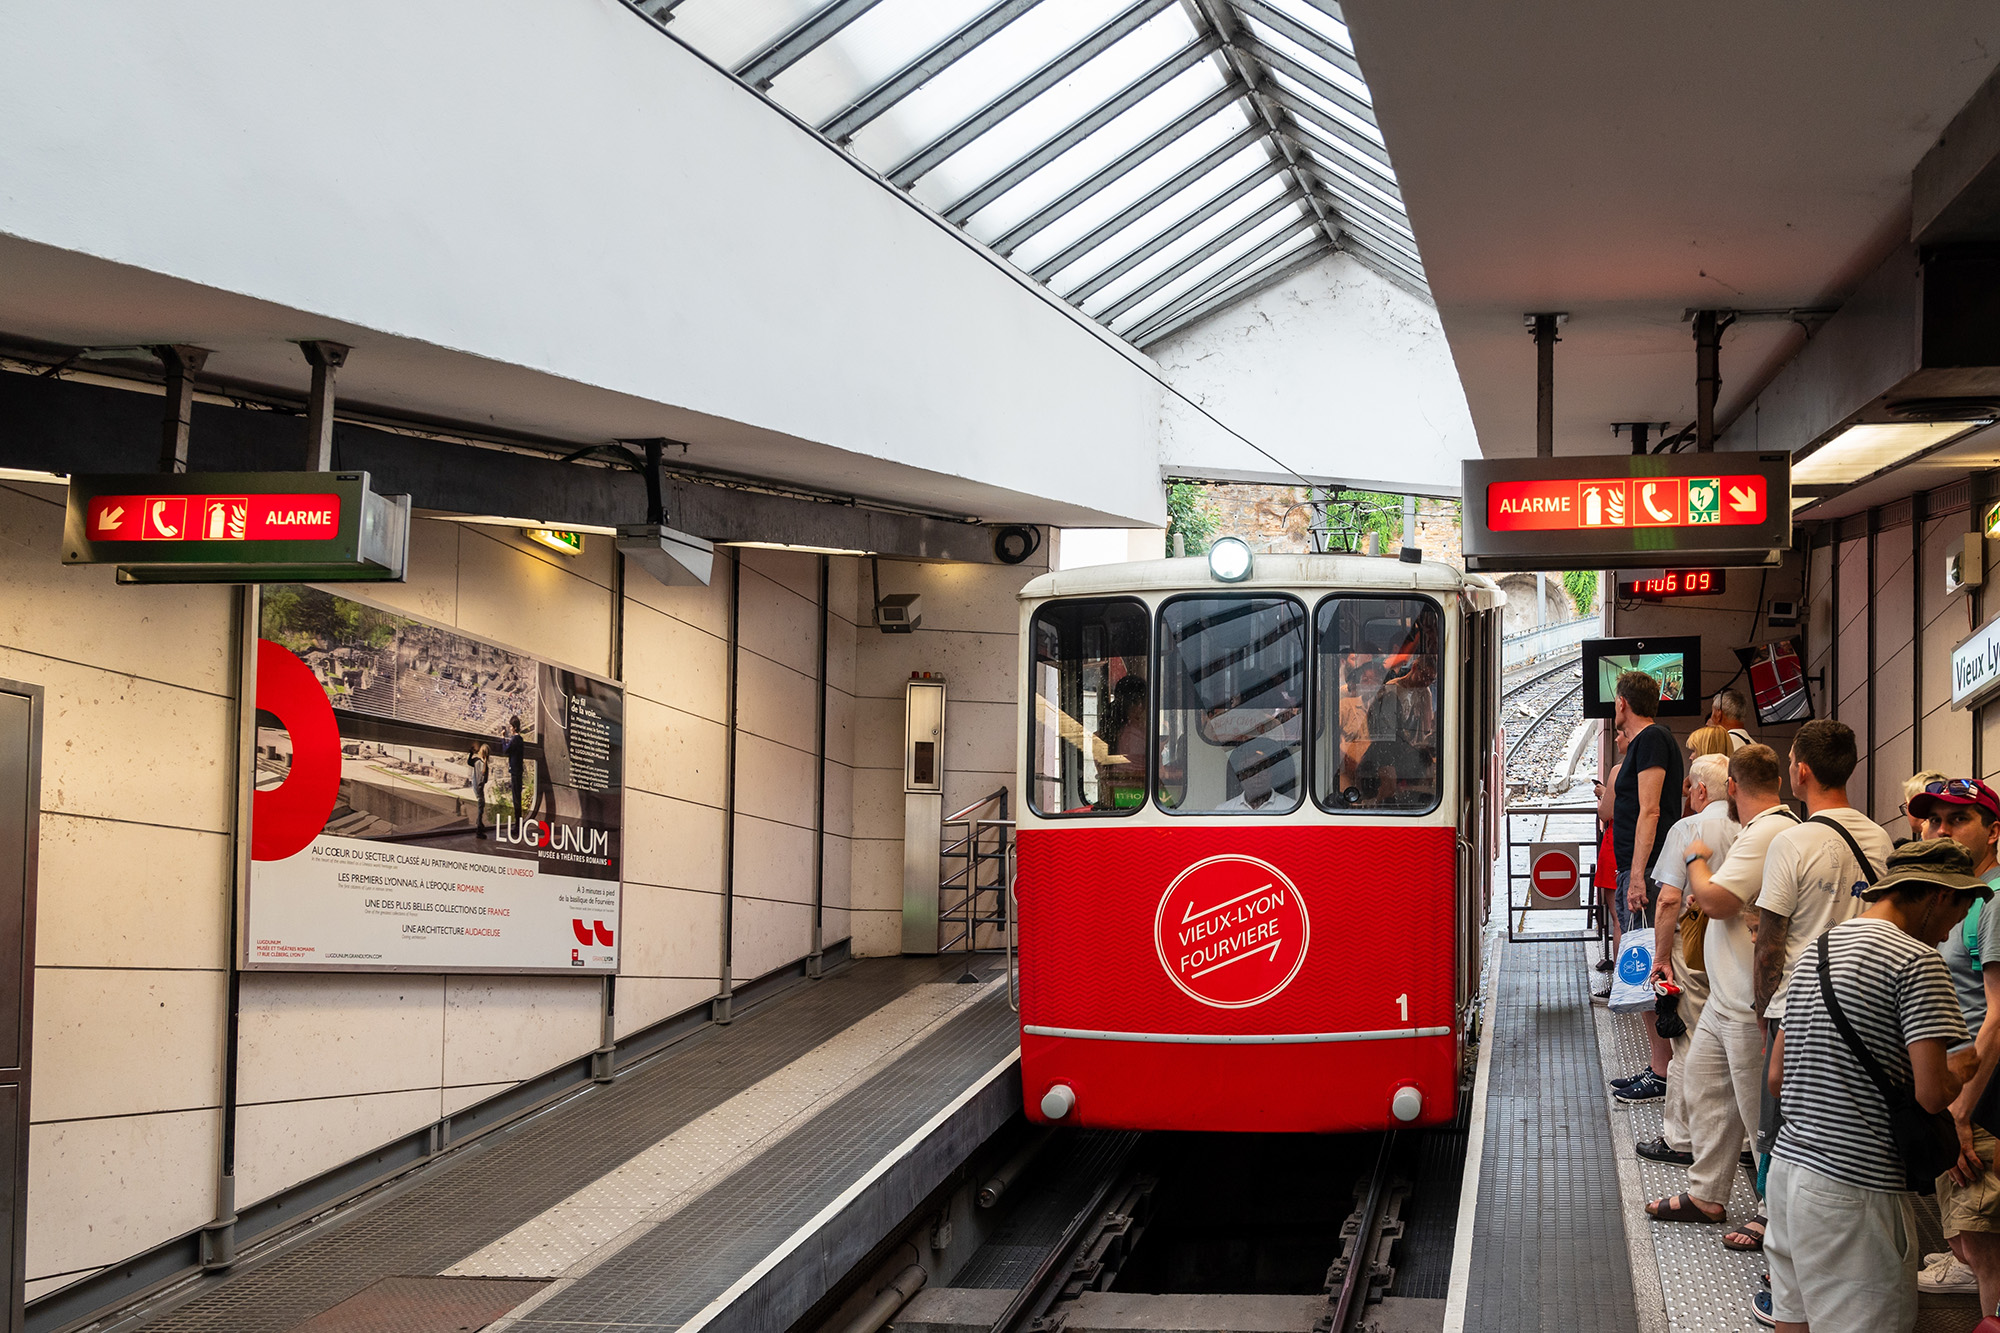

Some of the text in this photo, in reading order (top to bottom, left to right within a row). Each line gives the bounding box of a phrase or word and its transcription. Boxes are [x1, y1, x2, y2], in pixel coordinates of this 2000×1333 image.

[1500, 497, 1570, 513] ALARME
[266, 510, 332, 525] ALARME
[1690, 512, 1719, 523] DAE
[1686, 574, 1709, 590] 09
[1956, 637, 2000, 691] Vieux Ly
[572, 696, 579, 704] Au
[571, 704, 578, 714] de
[579, 706, 584, 715] la
[496, 814, 608, 856] LUGDUNUM
[312, 846, 323, 855] AU
[325, 847, 350, 858] CŒUR
[352, 850, 363, 859] DU
[365, 852, 395, 862] SECTEUR
[397, 855, 419, 865] CLASSÉ
[432, 859, 468, 870] PATRIMOINE
[469, 864, 497, 874] MONDIAL
[507, 868, 534, 877] L'UNESCO
[538, 850, 555, 859] MUSÉE
[586, 856, 607, 865] ROMAINS
[338, 873, 350, 882] LES
[352, 874, 383, 885] PREMIERS
[457, 884, 484, 893] ROMAINE
[365, 899, 380, 908] UNE
[382, 900, 394, 909] DES
[396, 901, 411, 910] PLUS
[413, 902, 433, 912] BELLES
[435, 903, 477, 914] COLLECTIONS
[488, 908, 510, 916] FRANCE
[570, 896, 588, 904] basilique
[1178, 890, 1284, 946] VIEUX-LYON
[402, 924, 500, 937] UNE ARCHITECTURE AUDACIEUSE
[1180, 918, 1280, 973] FOURVIERE
[1396, 993, 1408, 1021] 1
